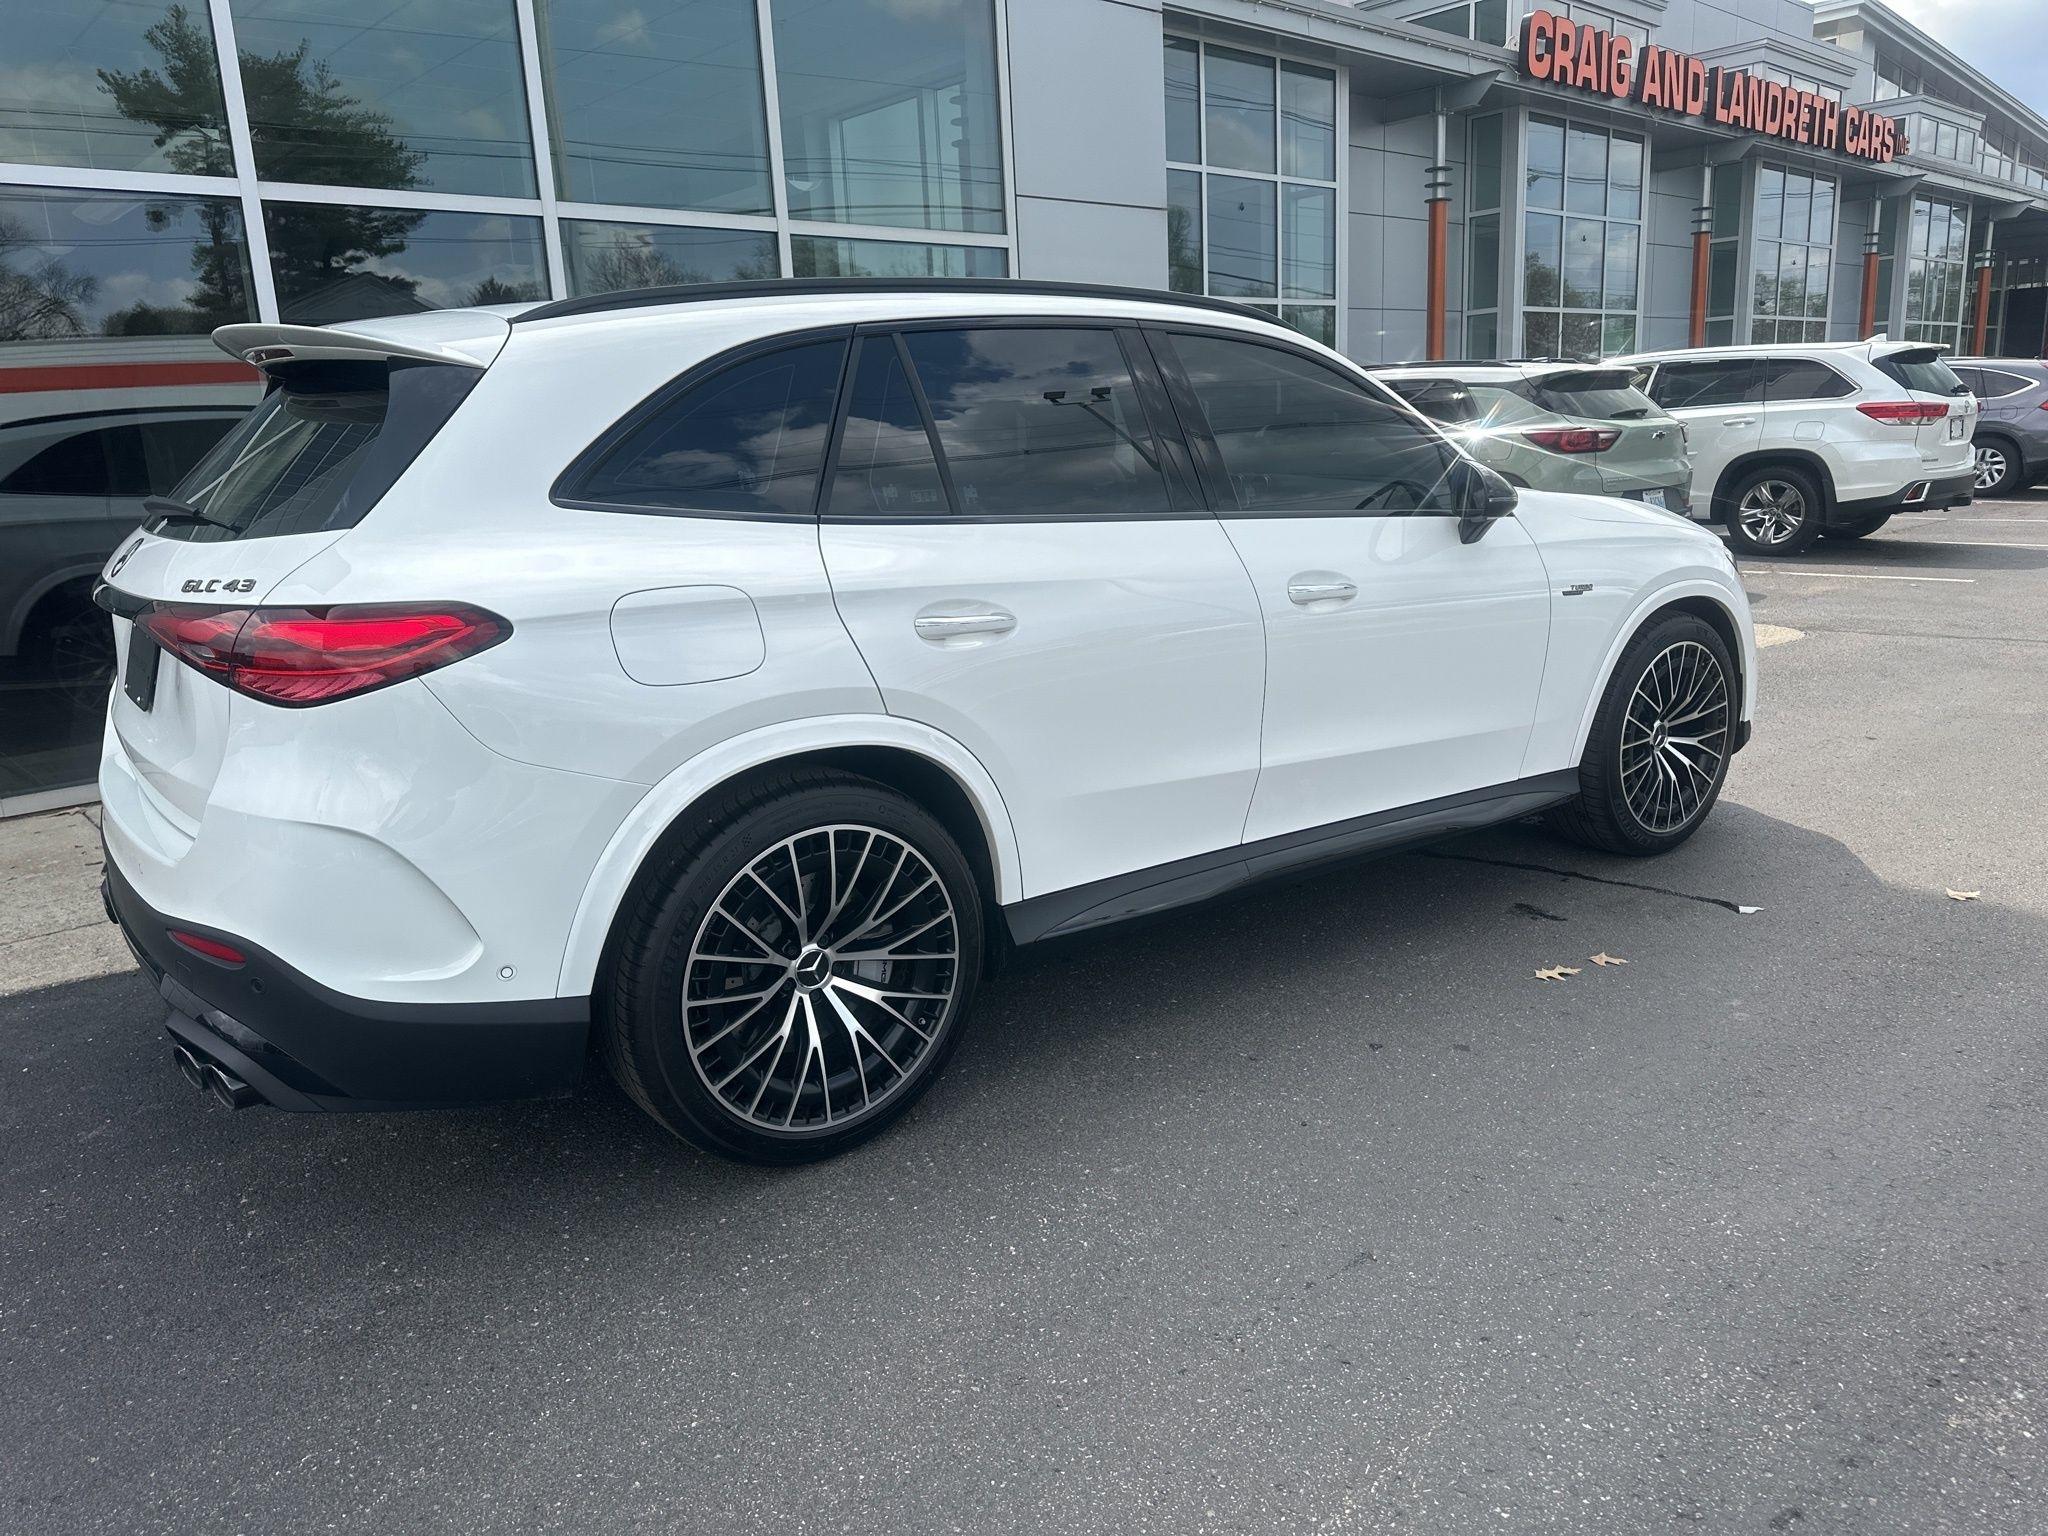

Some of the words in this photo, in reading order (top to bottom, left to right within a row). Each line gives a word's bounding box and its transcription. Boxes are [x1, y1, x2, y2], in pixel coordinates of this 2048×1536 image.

[1525, 9, 1633, 99] CRAIG
[1641, 44, 1706, 116] AND
[1713, 66, 1840, 149] LANDRETH
[1845, 105, 1895, 163] CARS
[181, 578, 222, 593] GLC
[222, 578, 257, 593] 43
